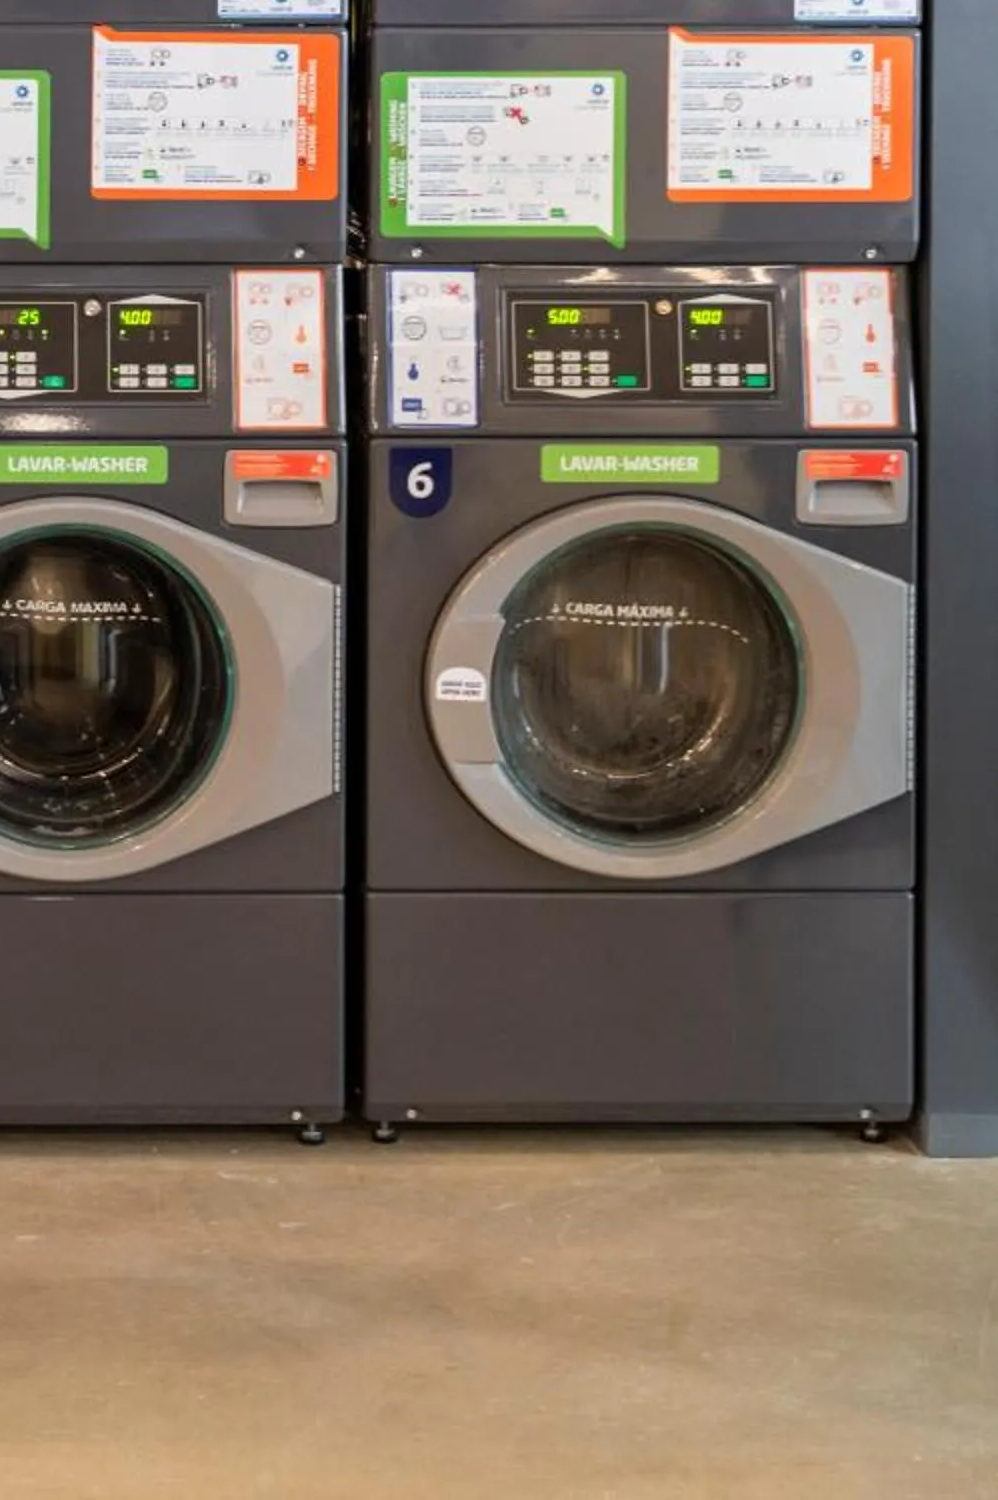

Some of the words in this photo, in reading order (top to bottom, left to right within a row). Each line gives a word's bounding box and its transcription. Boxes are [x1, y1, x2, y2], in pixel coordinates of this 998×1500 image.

[17, 309, 40, 326] 25
[7, 456, 149, 473] LAVAR-WASHER
[560, 455, 699, 473] LAVAR-WASHER
[406, 462, 434, 498] 6
[15, 599, 67, 613] CARGA
[565, 602, 615, 617] CARGA
